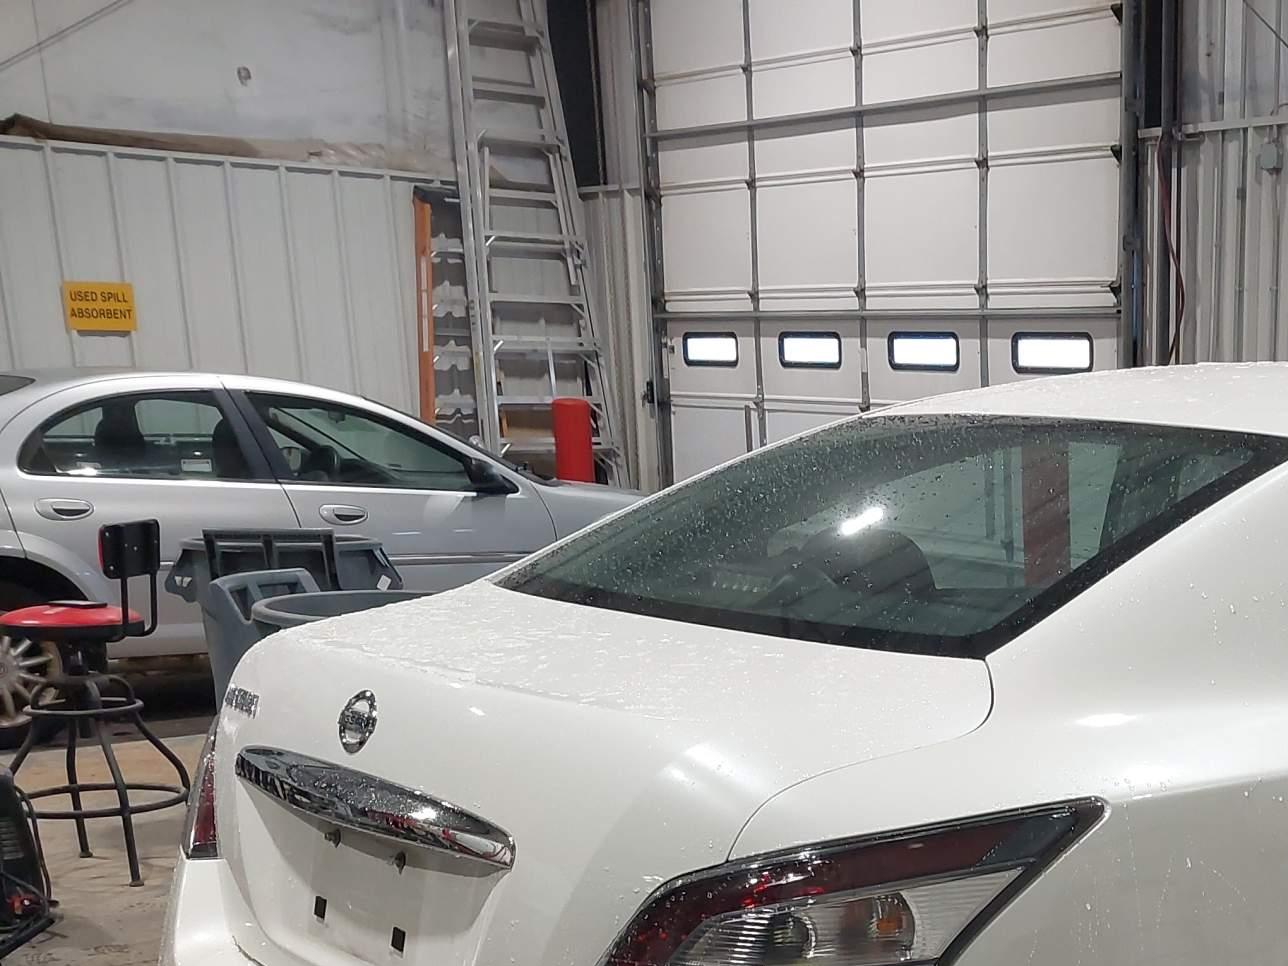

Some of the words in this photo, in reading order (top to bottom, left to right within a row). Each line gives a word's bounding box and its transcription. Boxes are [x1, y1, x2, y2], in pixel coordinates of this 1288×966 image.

[69, 290, 98, 302] USED
[100, 291, 128, 303] SPILL
[70, 307, 132, 320] ABSORBENT
